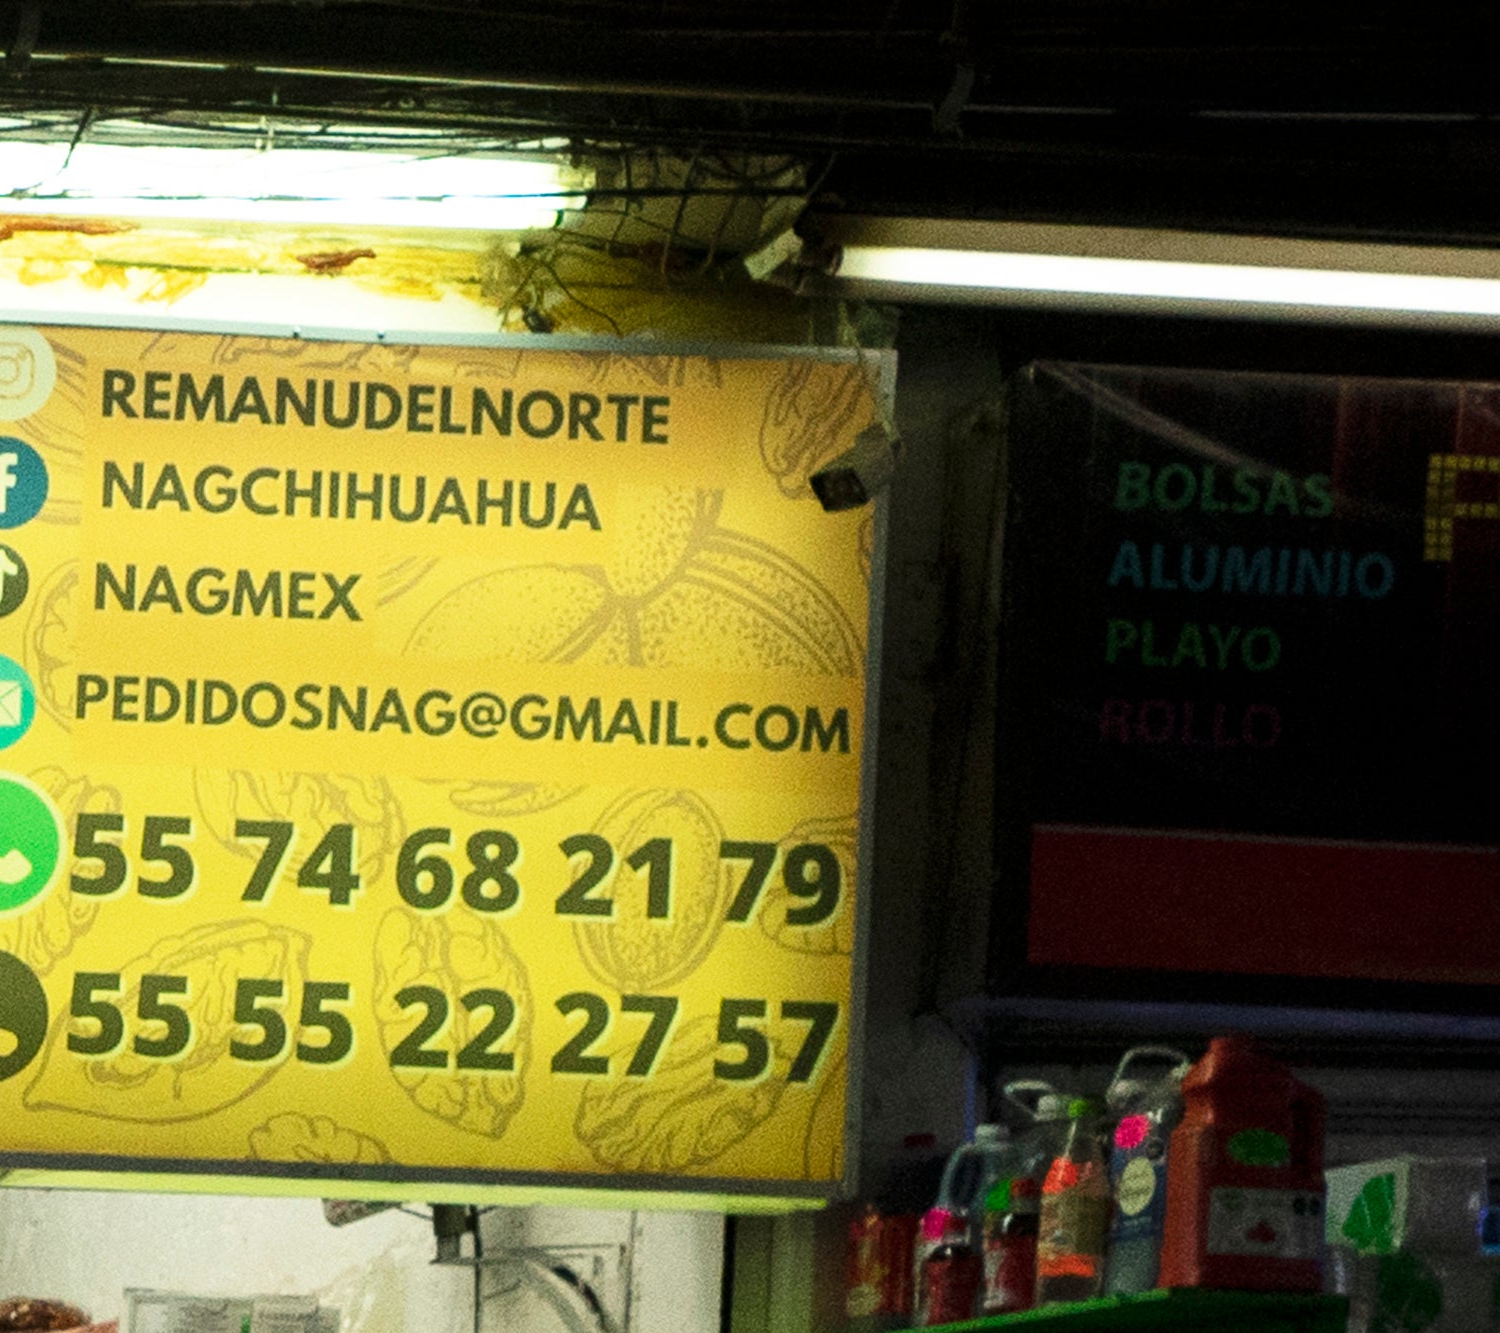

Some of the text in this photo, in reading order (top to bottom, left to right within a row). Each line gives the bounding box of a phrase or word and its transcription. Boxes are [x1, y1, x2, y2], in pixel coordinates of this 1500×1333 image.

[101, 370, 671, 444] REMANUDELNORTE
[101, 461, 602, 532] NAGCHIHUAHUA
[1112, 459, 1335, 518] BOLSAS
[93, 564, 364, 622] NAGMEX
[1106, 541, 1397, 600] ALUMINIO
[1102, 617, 1284, 673] PLAYO
[75, 674, 851, 754] PEDIDOSNAG@GMAIL.COM
[1097, 694, 1284, 750] ROLLO
[71, 812, 842, 926] 55 74 68 21 79
[67, 971, 840, 1084] 55 55 22 27 57
